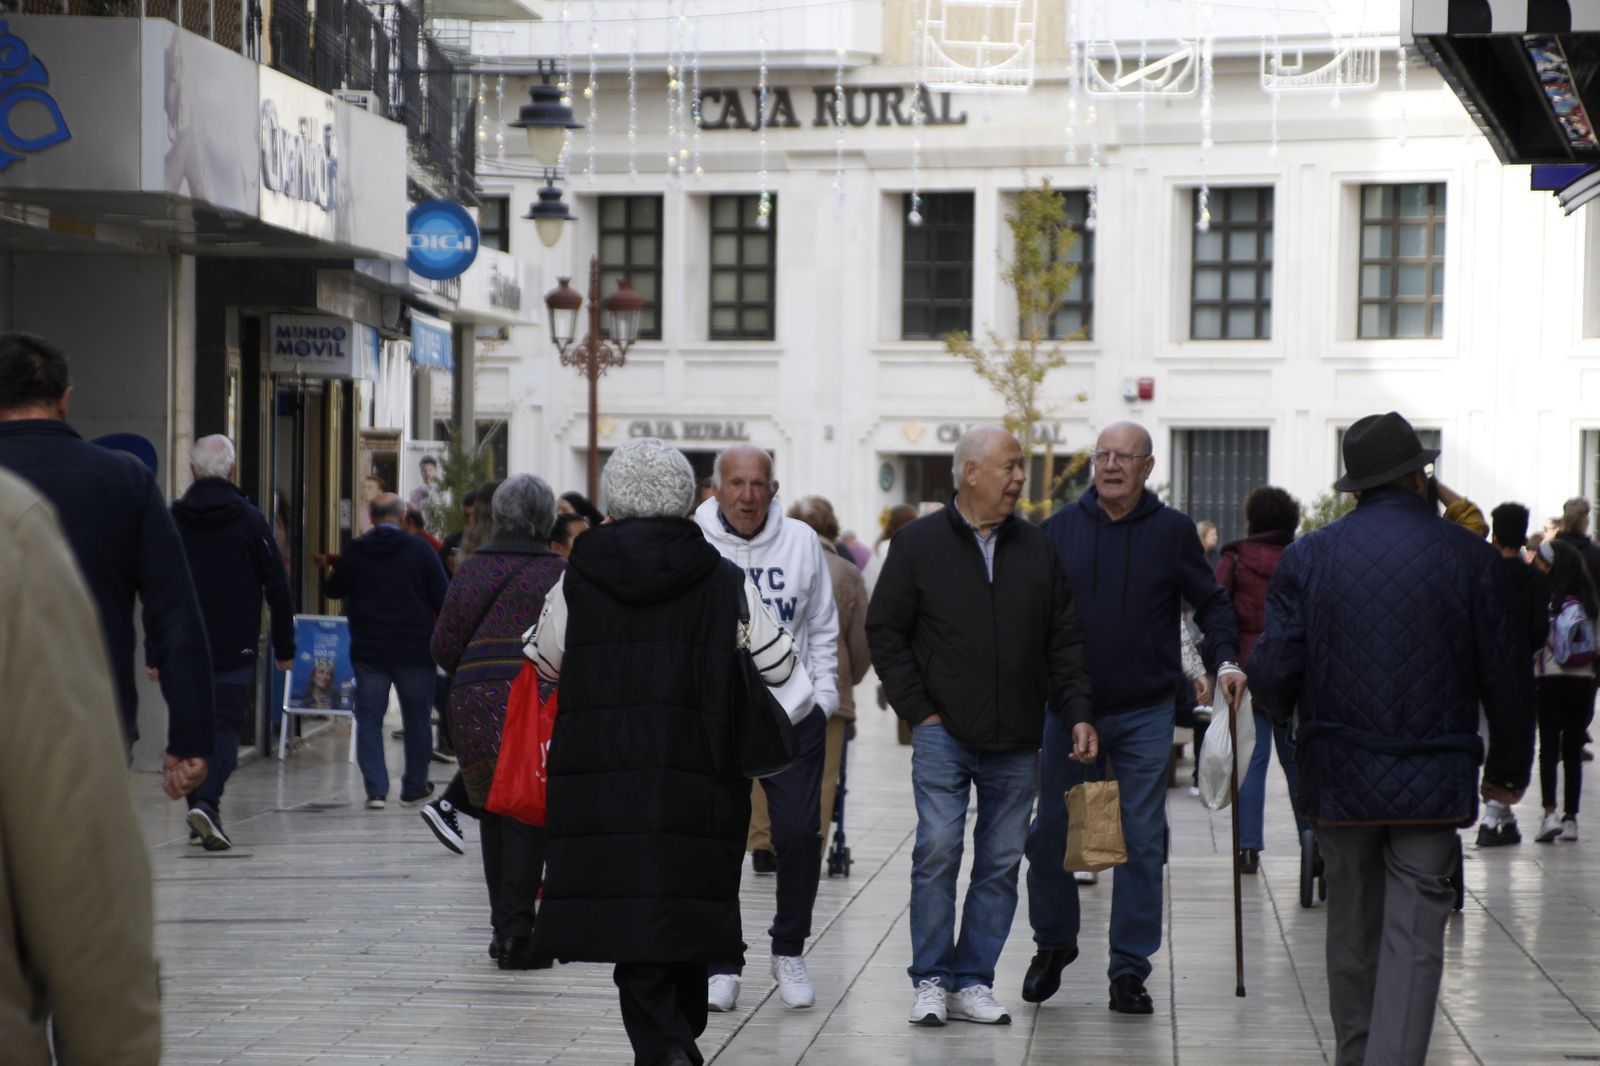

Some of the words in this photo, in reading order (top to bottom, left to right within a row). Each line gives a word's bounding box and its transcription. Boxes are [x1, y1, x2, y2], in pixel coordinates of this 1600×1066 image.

[699, 88, 801, 131] CAJA
[813, 86, 967, 127] RURAL
[406, 233, 472, 250] DIGI
[275, 326, 345, 341] MUNDO
[275, 340, 345, 357] MOVIL
[628, 421, 677, 440] CAJA
[682, 421, 750, 441] RURAL
[748, 567, 785, 591] YC
